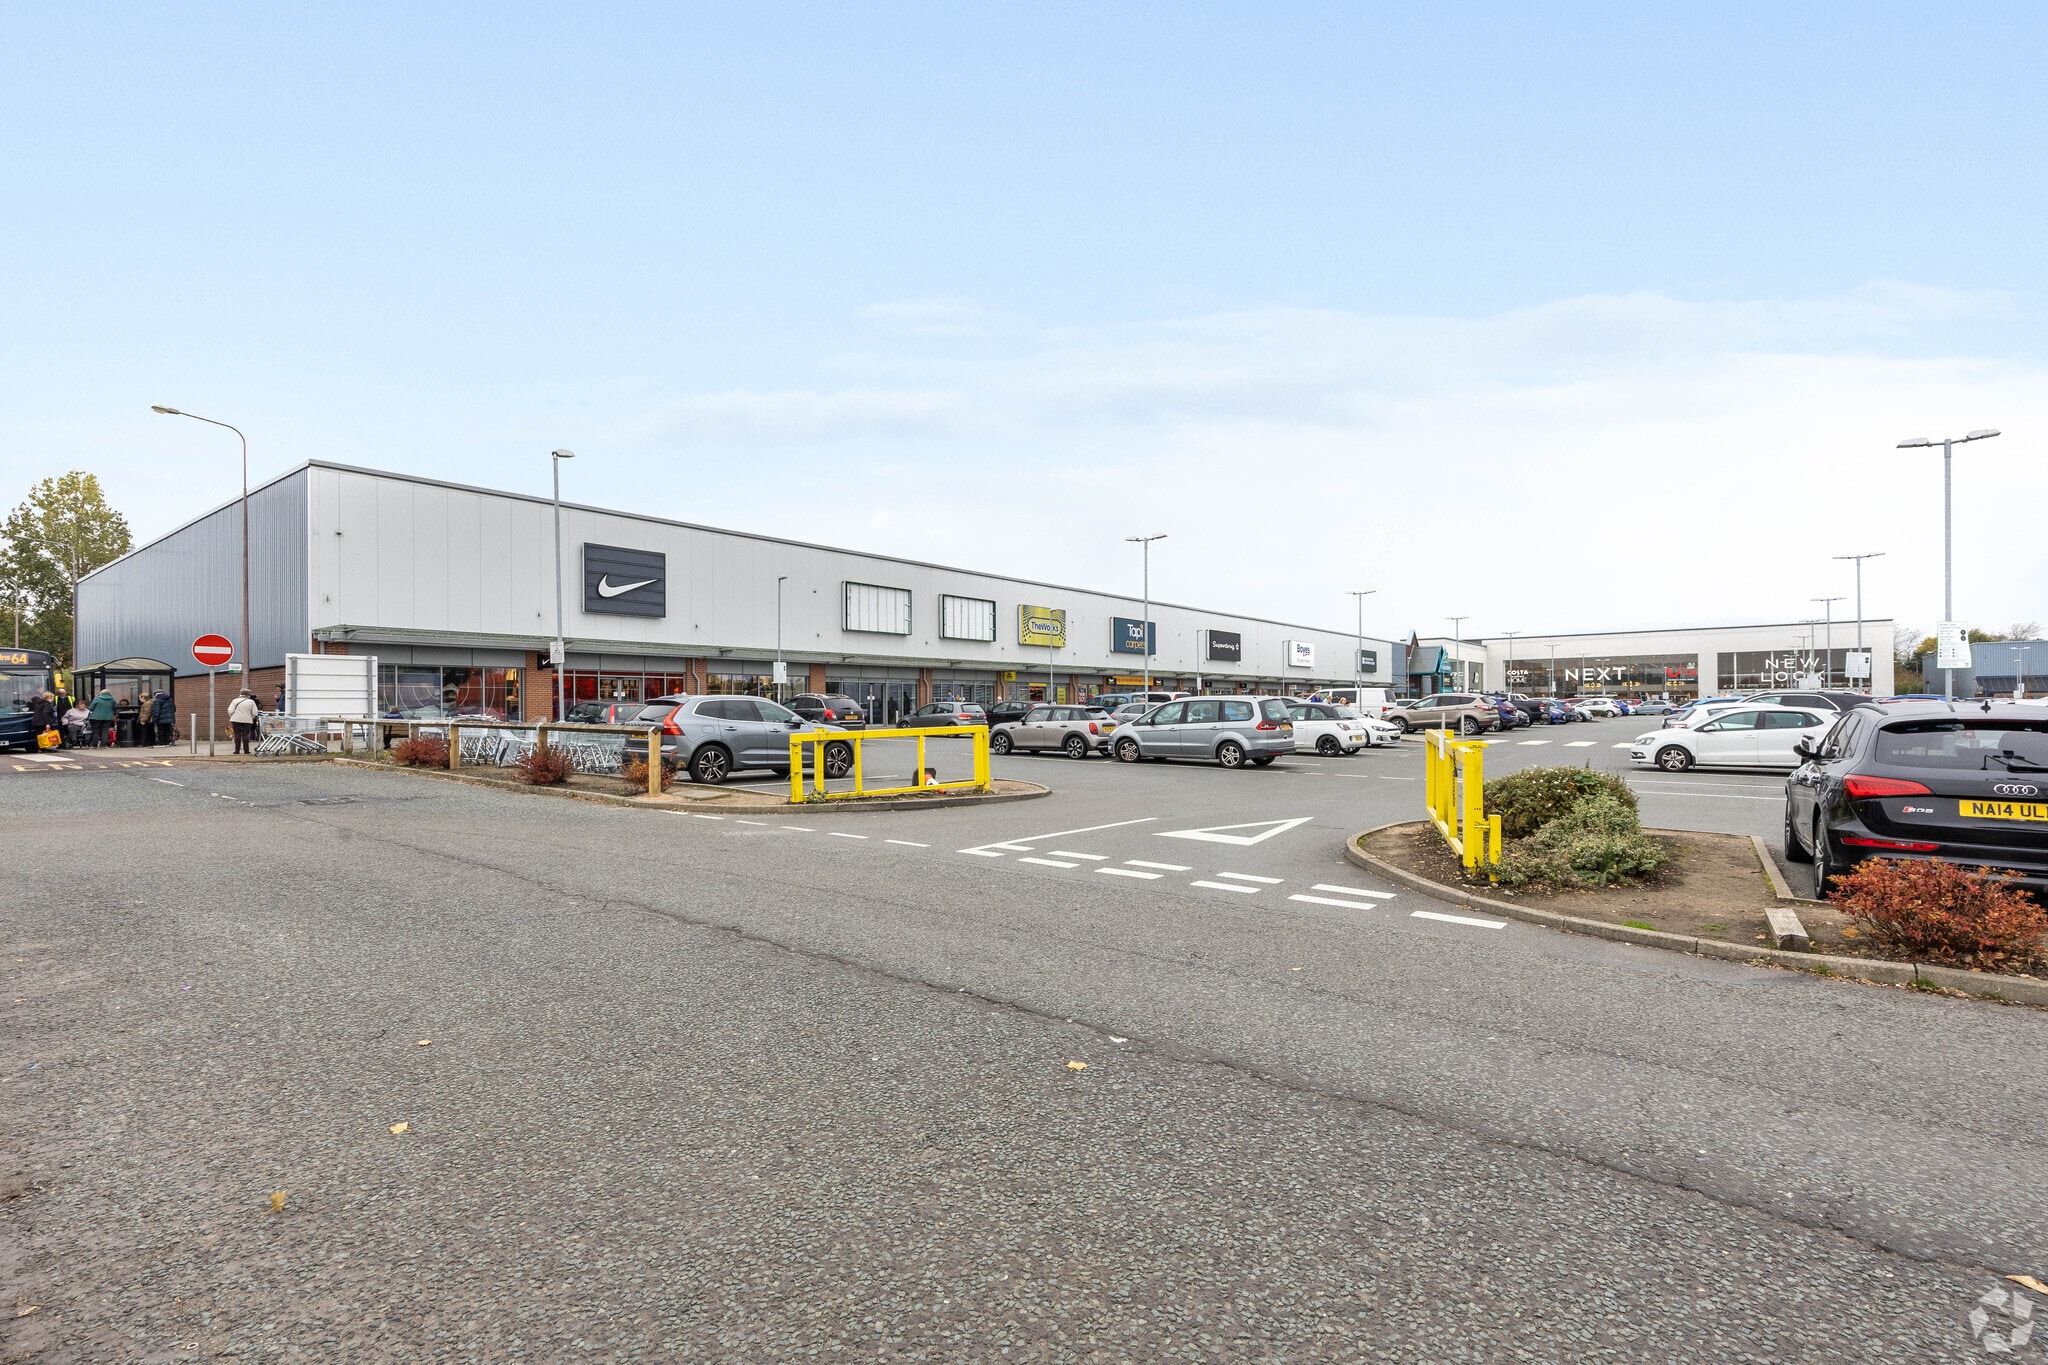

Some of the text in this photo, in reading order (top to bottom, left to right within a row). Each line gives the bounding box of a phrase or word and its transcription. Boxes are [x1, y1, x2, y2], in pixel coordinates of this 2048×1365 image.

[1127, 623, 1144, 640] Tapi
[1296, 643, 1311, 656] Boyes
[11, 652, 28, 665] 64
[1765, 657, 1820, 669] NEW
[1565, 666, 1627, 682] NEXT
[1972, 801, 2048, 819] NA14 UL
